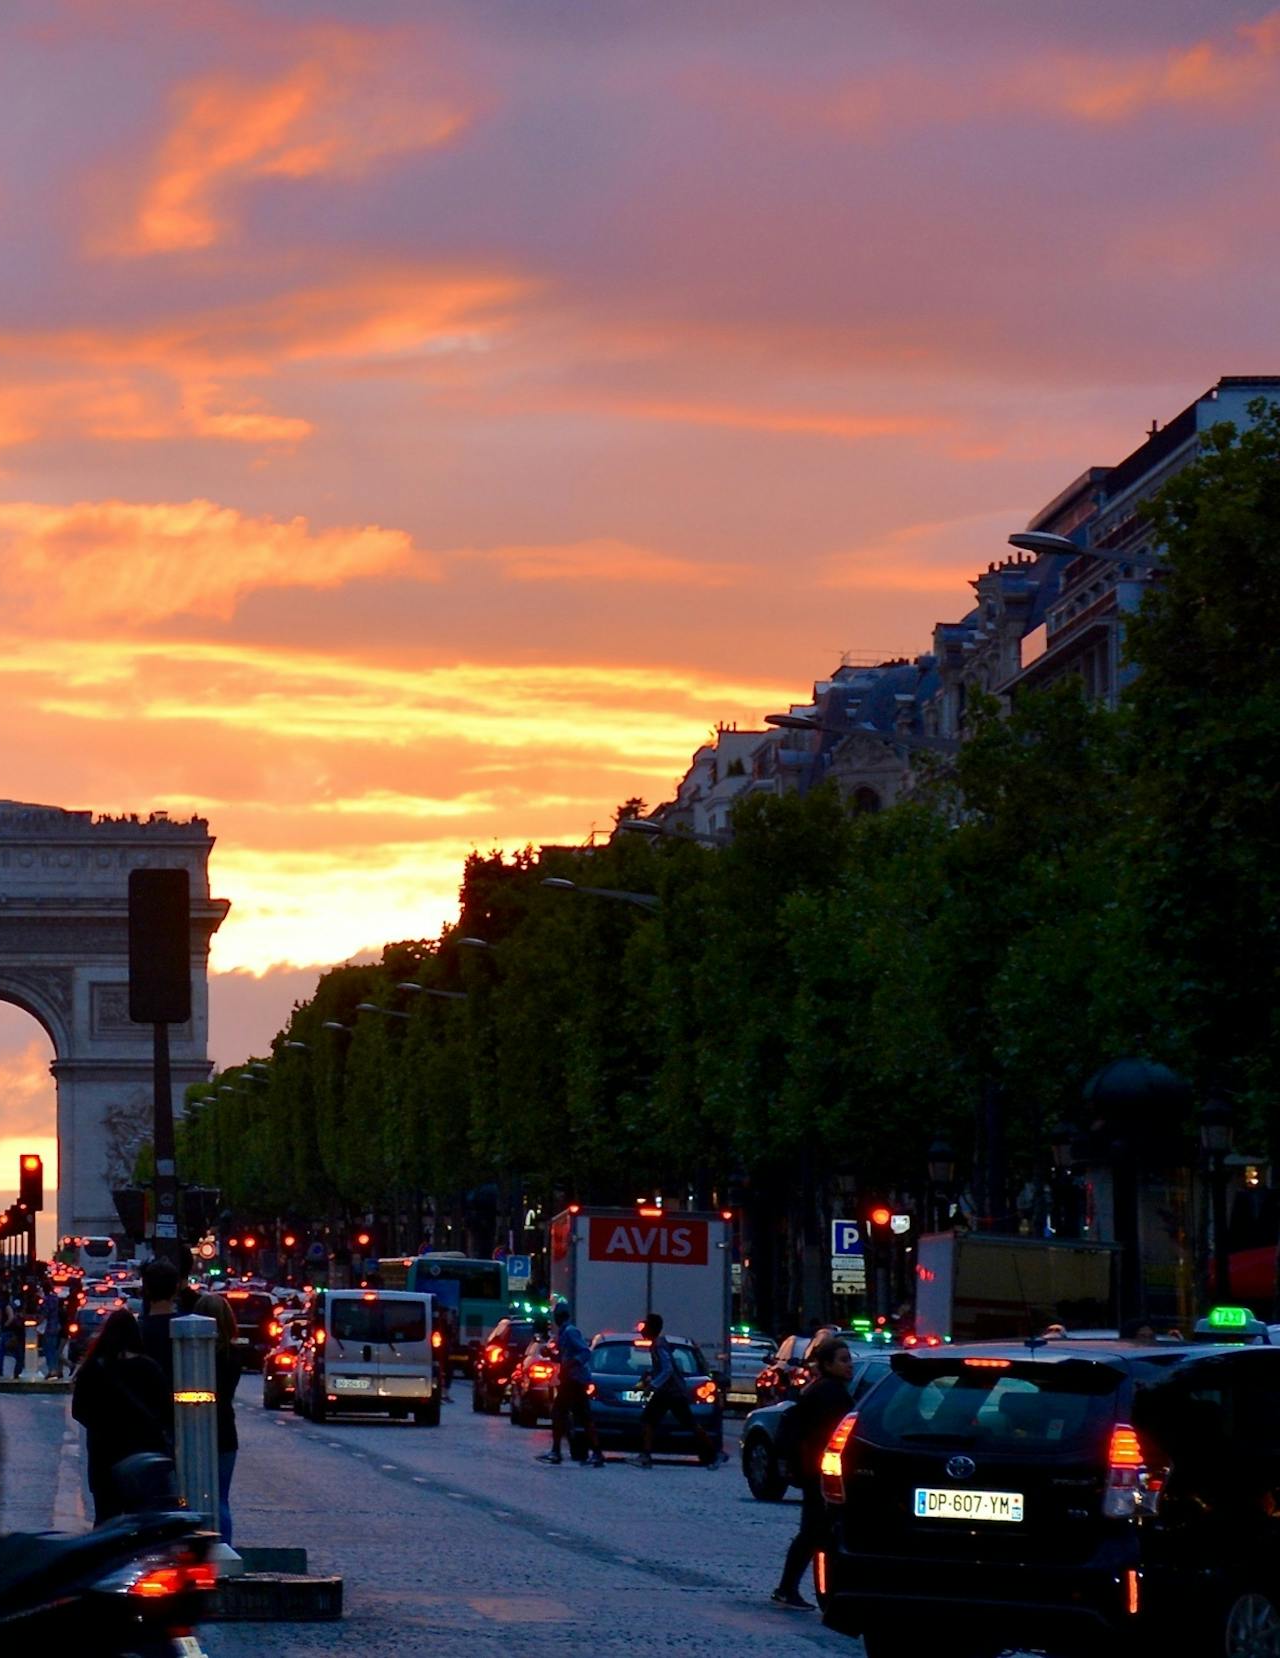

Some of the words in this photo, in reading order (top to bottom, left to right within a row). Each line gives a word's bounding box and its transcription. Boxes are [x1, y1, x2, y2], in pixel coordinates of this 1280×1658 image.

[606, 1226, 692, 1257] AVIS
[843, 1227, 859, 1250] P
[513, 1260, 524, 1275] P
[1215, 1310, 1242, 1324] TAXI
